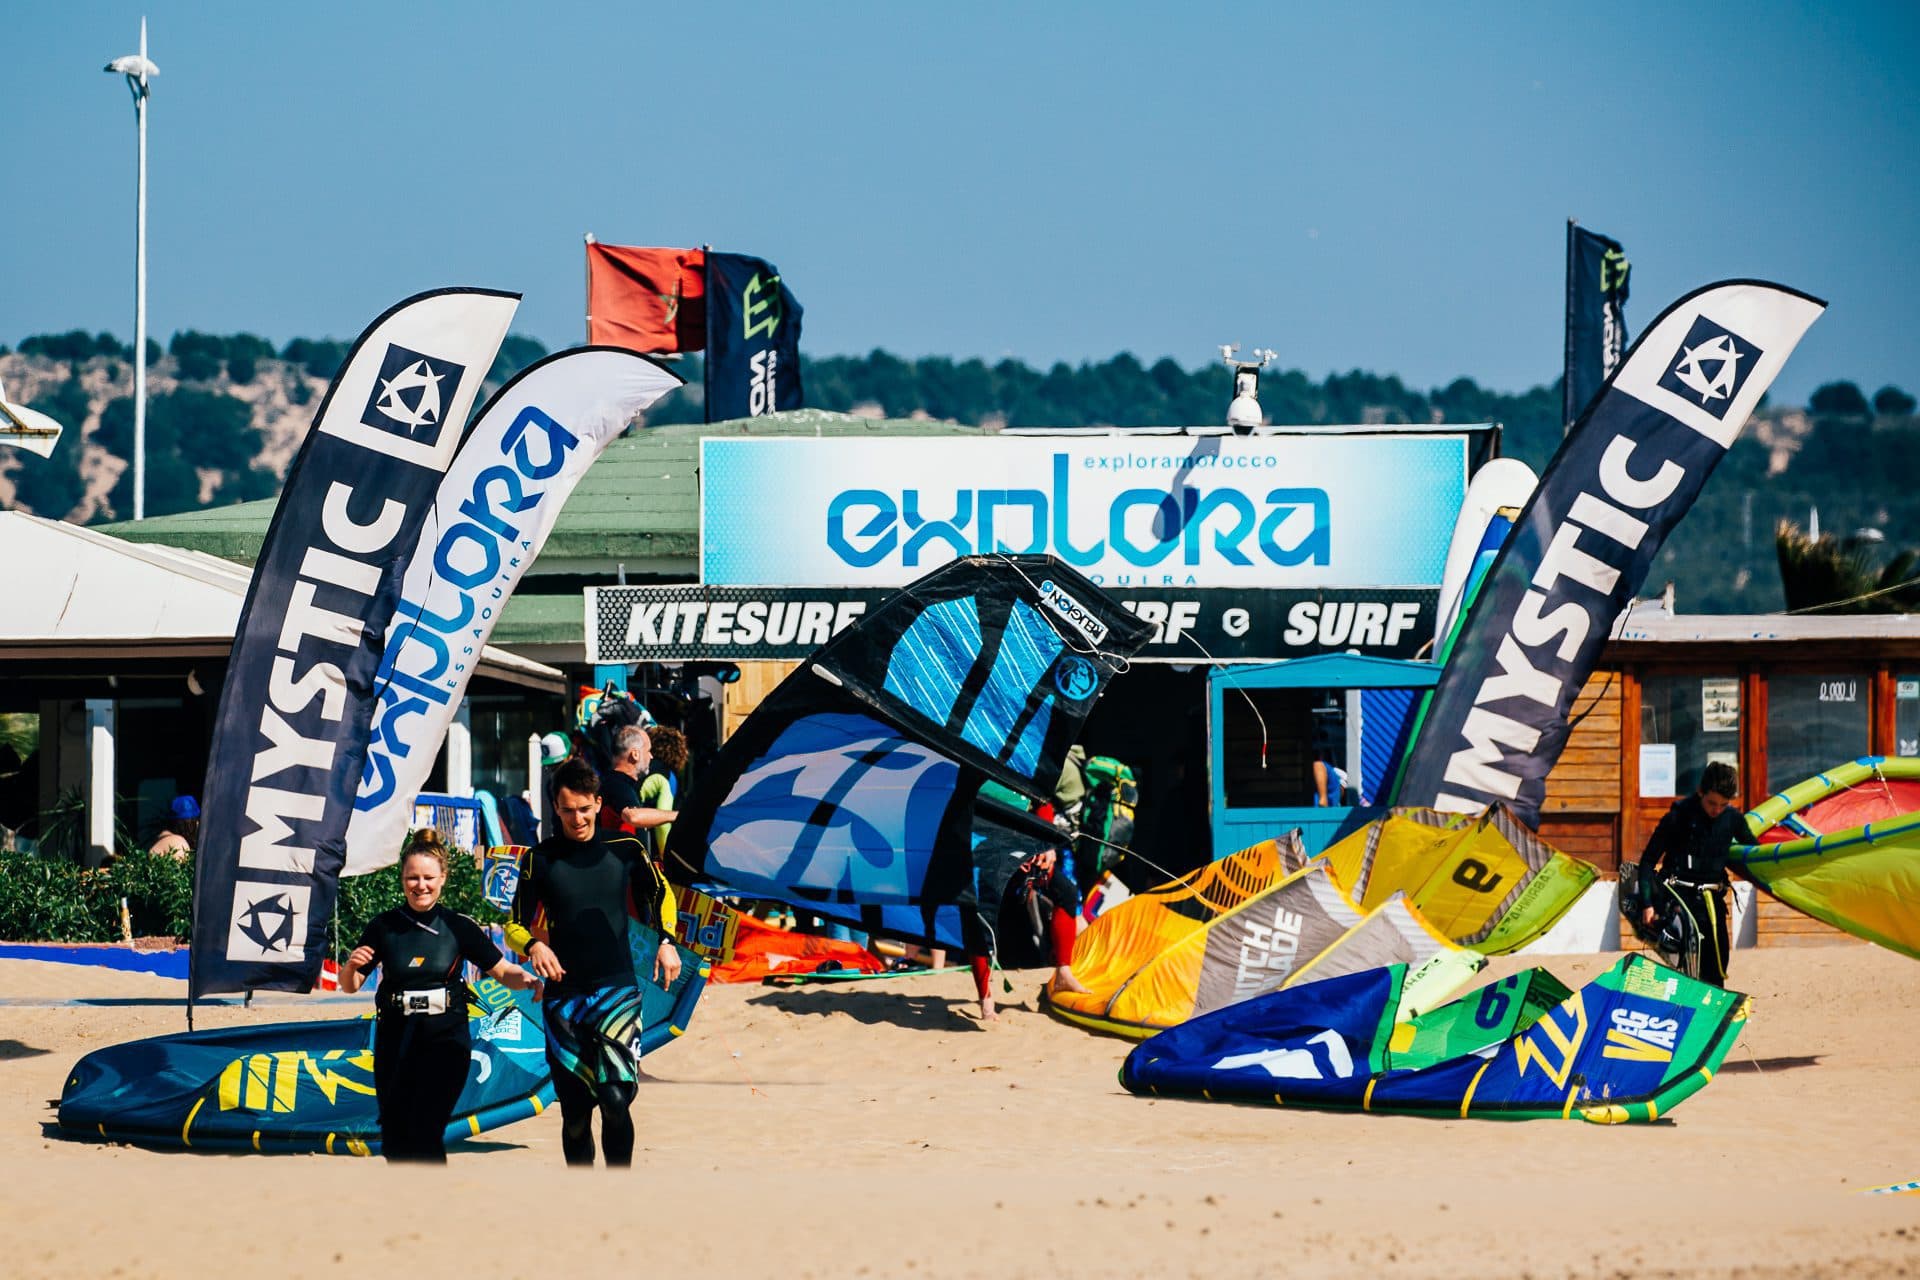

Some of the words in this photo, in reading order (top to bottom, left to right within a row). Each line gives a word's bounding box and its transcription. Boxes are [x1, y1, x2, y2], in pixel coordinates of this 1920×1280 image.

[827, 453, 1330, 568] explora
[1084, 452, 1278, 471] exploramorocco
[239, 481, 407, 873] MYSTIC
[447, 541, 531, 689] ESSAOUIRA
[1284, 601, 1420, 646] SURF
[1443, 434, 1686, 800] MYSTIC
